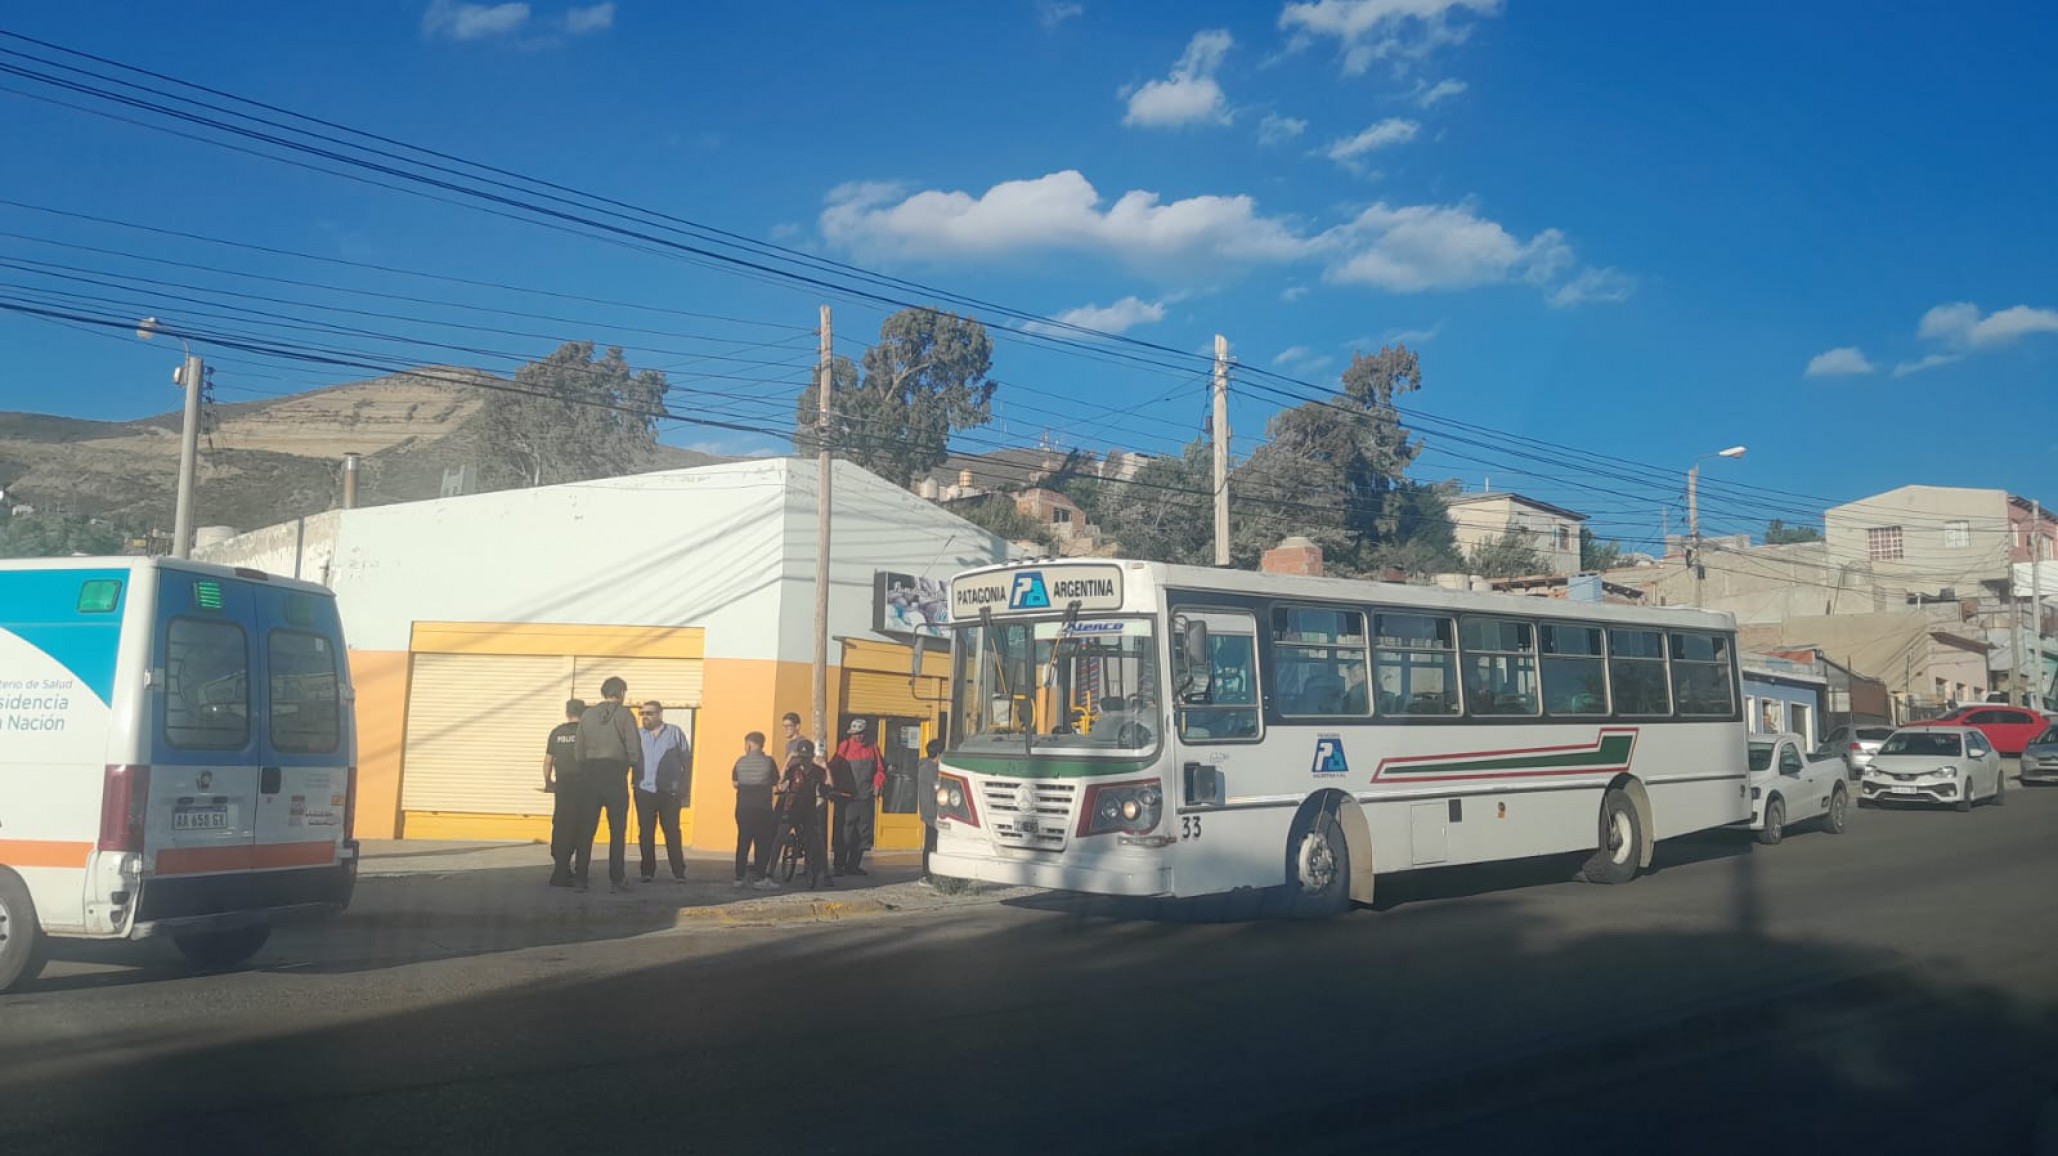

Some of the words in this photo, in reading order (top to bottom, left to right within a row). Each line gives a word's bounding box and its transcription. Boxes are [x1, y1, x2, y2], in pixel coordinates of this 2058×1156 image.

[957, 586, 1007, 606] PATAGONIA
[1053, 578, 1114, 598] ARGENTINA
[26, 679, 39, 690] de
[42, 680, 73, 690] Salud
[0, 693, 69, 710] sidencia
[8, 713, 65, 731] Nación
[1182, 815, 1202, 839] 33
